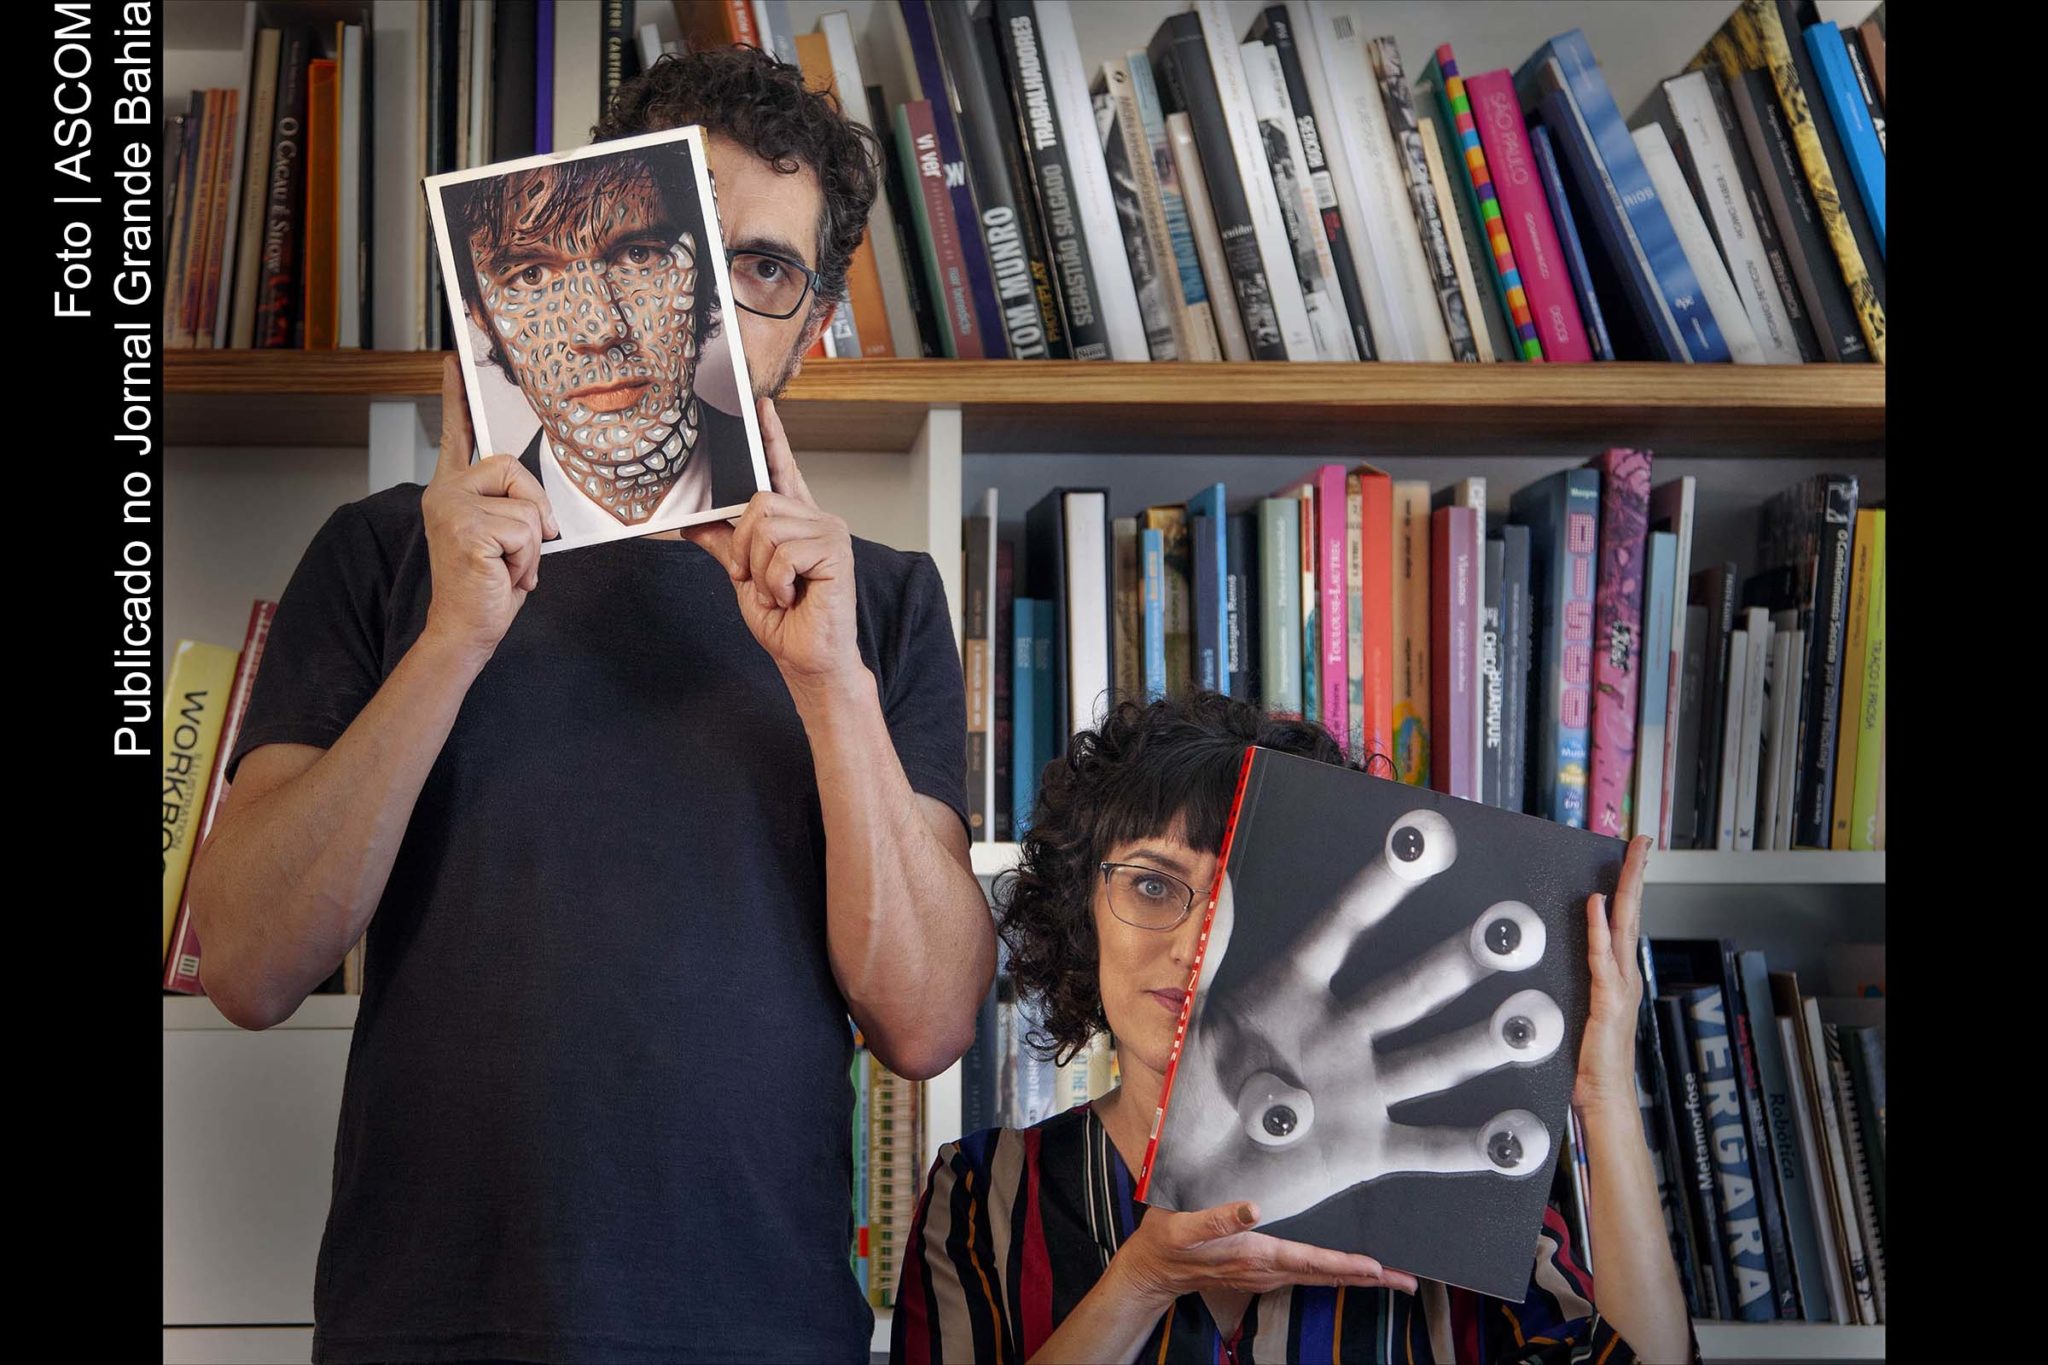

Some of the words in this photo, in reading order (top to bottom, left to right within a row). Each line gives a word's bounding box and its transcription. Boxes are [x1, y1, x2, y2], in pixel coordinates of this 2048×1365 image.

[279, 117, 299, 136] O
[1010, 15, 1057, 150] TRABALHADORES
[1042, 164, 1076, 239] SALGADO
[983, 205, 1030, 301] MUNRO
[1055, 239, 1094, 328] SEBASTIÃO
[1006, 303, 1043, 360] TOM
[1484, 631, 1499, 676] CHICO
[1562, 512, 1596, 729] DISCO
[163, 690, 208, 860] WORKBO
[1684, 1071, 1714, 1191] Metamorfose
[1692, 990, 1774, 1309] VERGARA
[1769, 1092, 1795, 1181] Robótica
